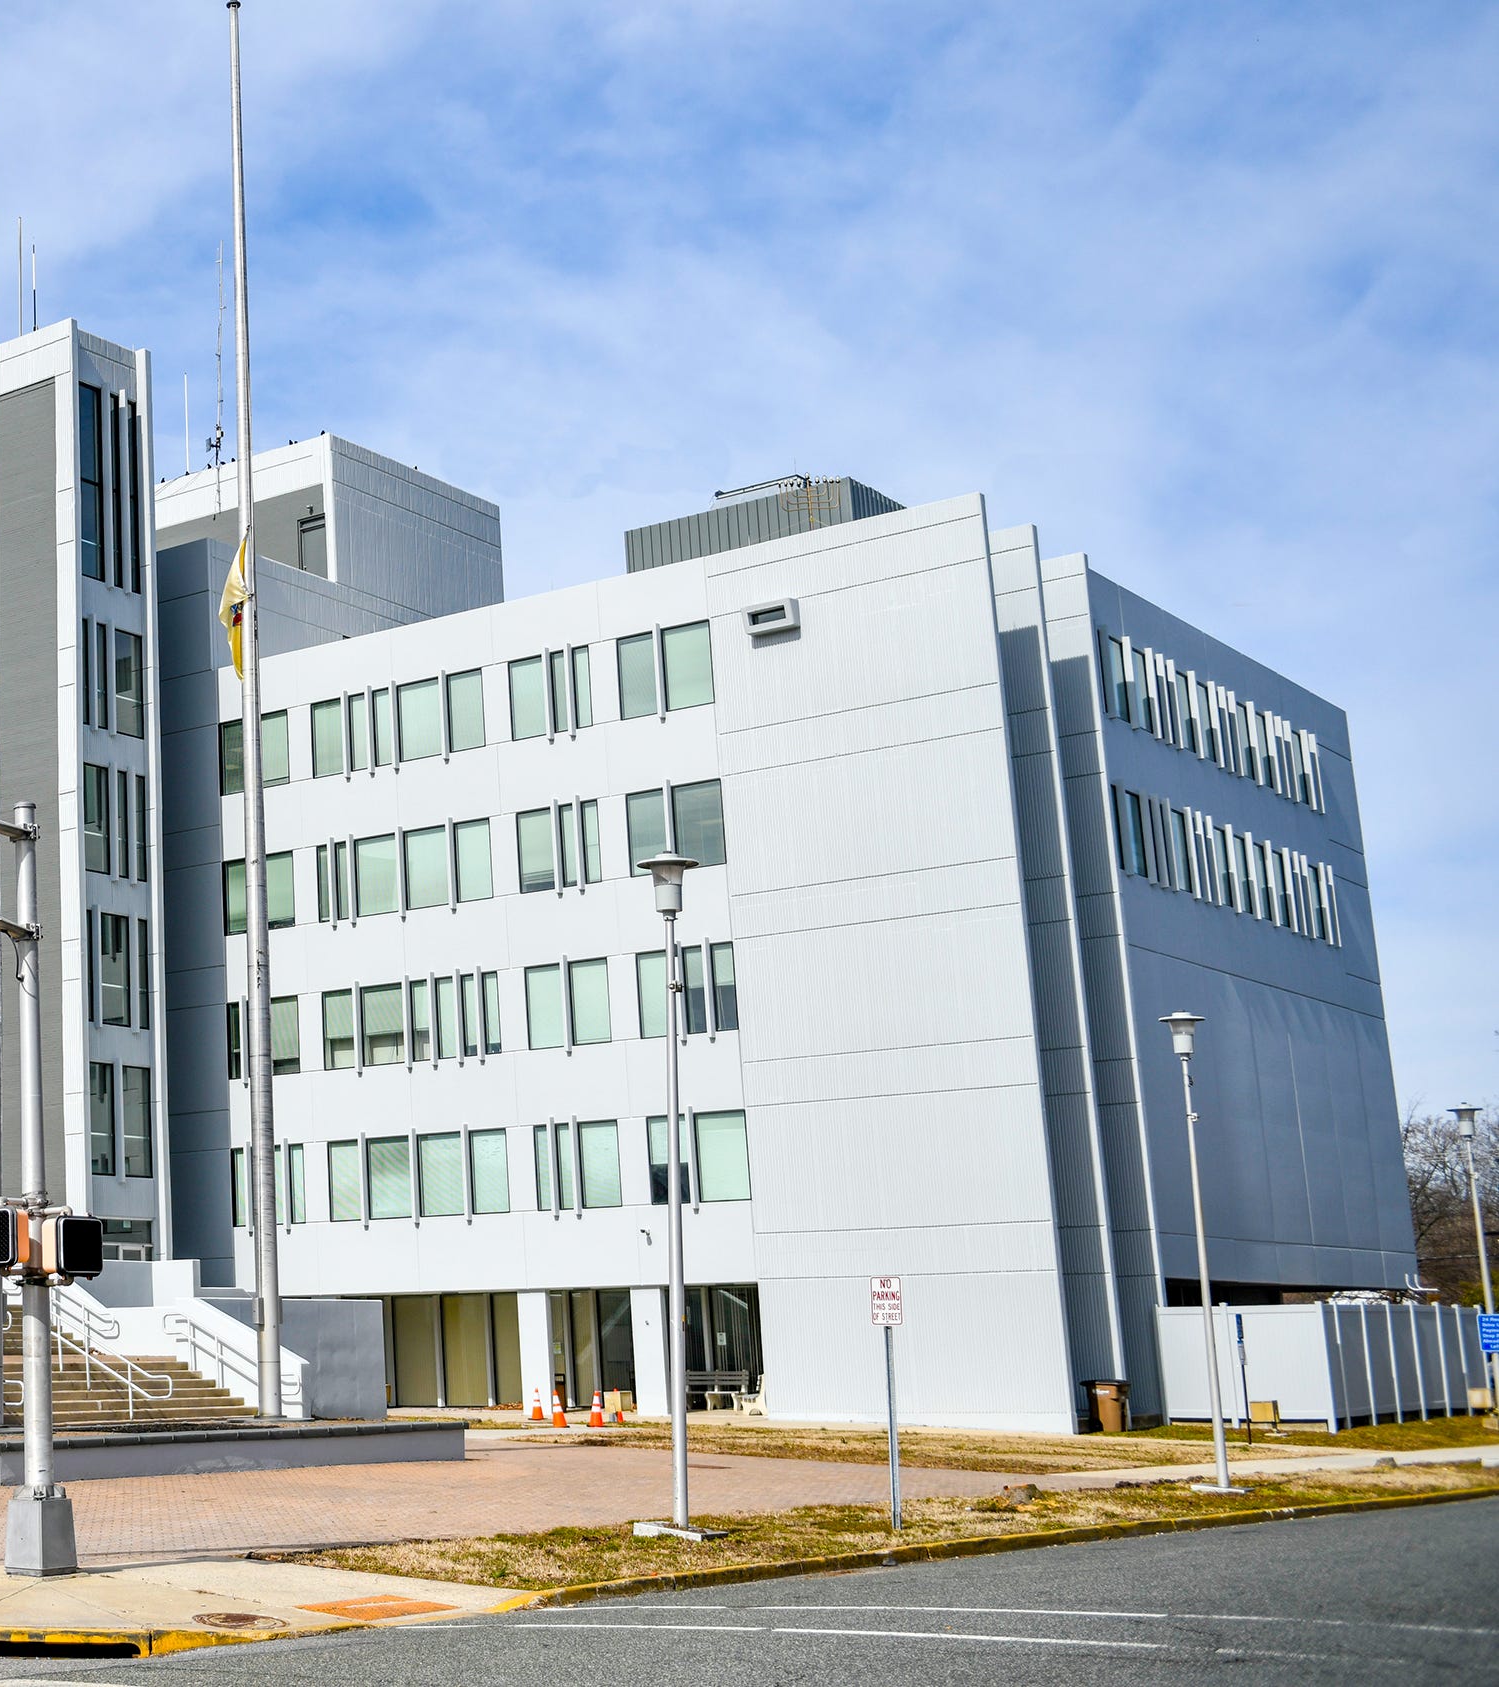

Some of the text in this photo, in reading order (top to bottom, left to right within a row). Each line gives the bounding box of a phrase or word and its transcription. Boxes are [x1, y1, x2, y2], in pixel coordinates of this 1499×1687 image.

[879, 1279, 892, 1289] NO
[872, 1291, 900, 1301] PARKING
[873, 1312, 901, 1321] OF STREET
